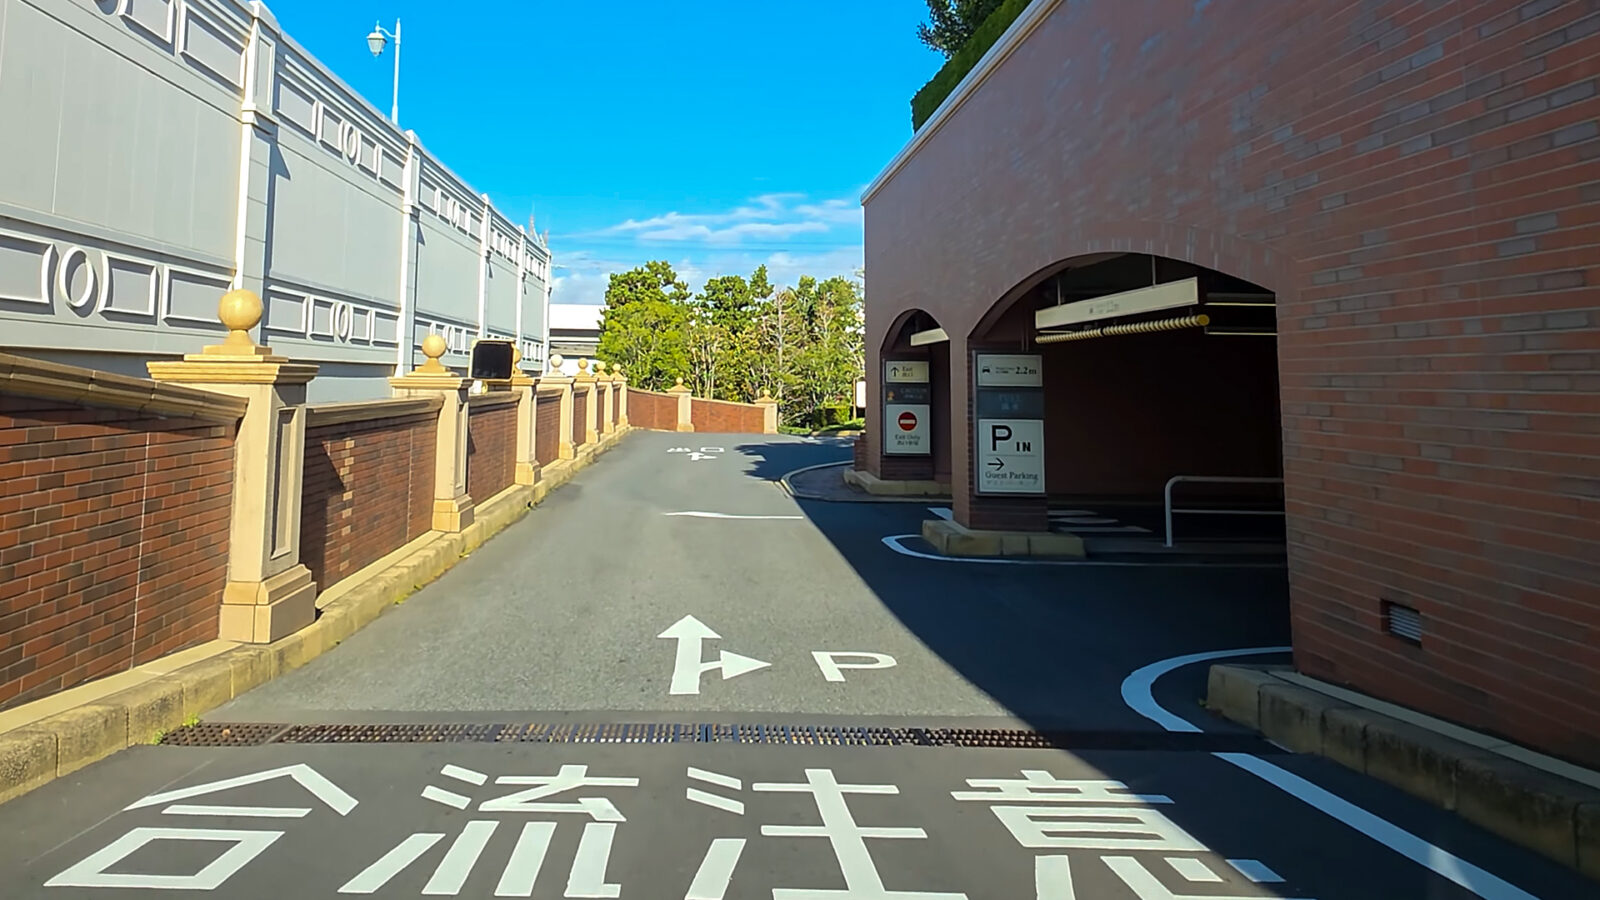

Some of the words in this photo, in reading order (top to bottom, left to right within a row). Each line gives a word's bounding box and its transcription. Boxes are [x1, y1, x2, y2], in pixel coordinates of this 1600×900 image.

[991, 425, 1013, 451] P
[1016, 441, 1031, 452] IN
[985, 471, 1008, 479] Guest
[1009, 471, 1039, 481] Parking
[811, 651, 898, 683] P
[43, 763, 1317, 900] 合流注意
